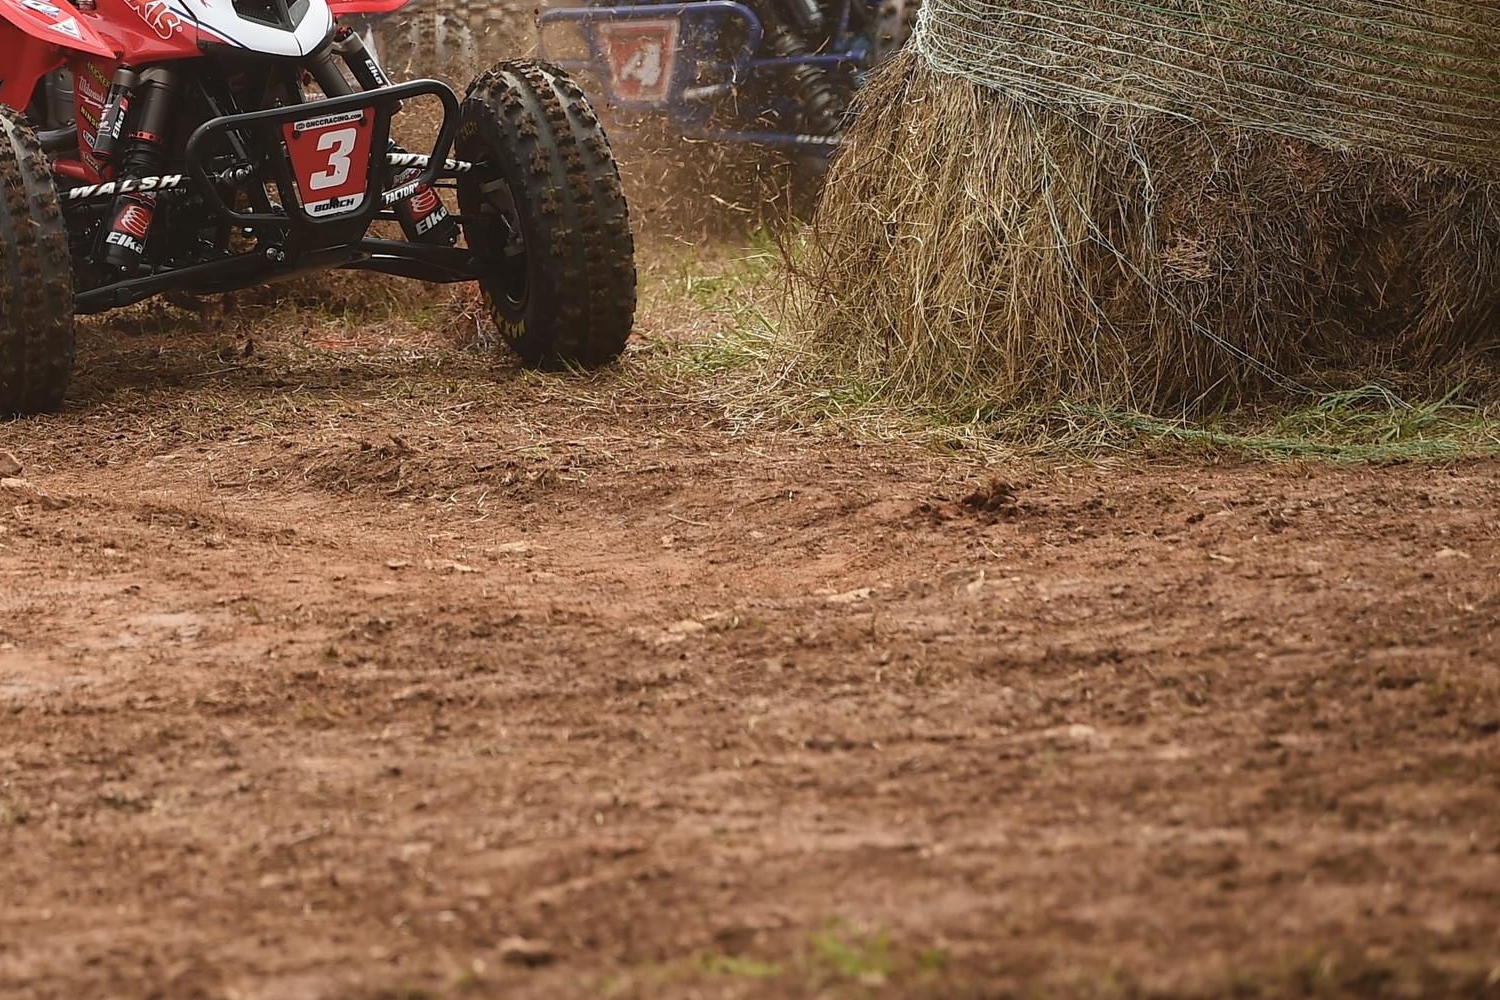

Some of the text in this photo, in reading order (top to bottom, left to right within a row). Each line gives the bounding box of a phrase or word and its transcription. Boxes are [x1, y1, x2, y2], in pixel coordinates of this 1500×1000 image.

[309, 127, 357, 191] 3
[69, 174, 182, 200] WALSH
[415, 205, 448, 236] Elka
[105, 231, 144, 255] Elka
